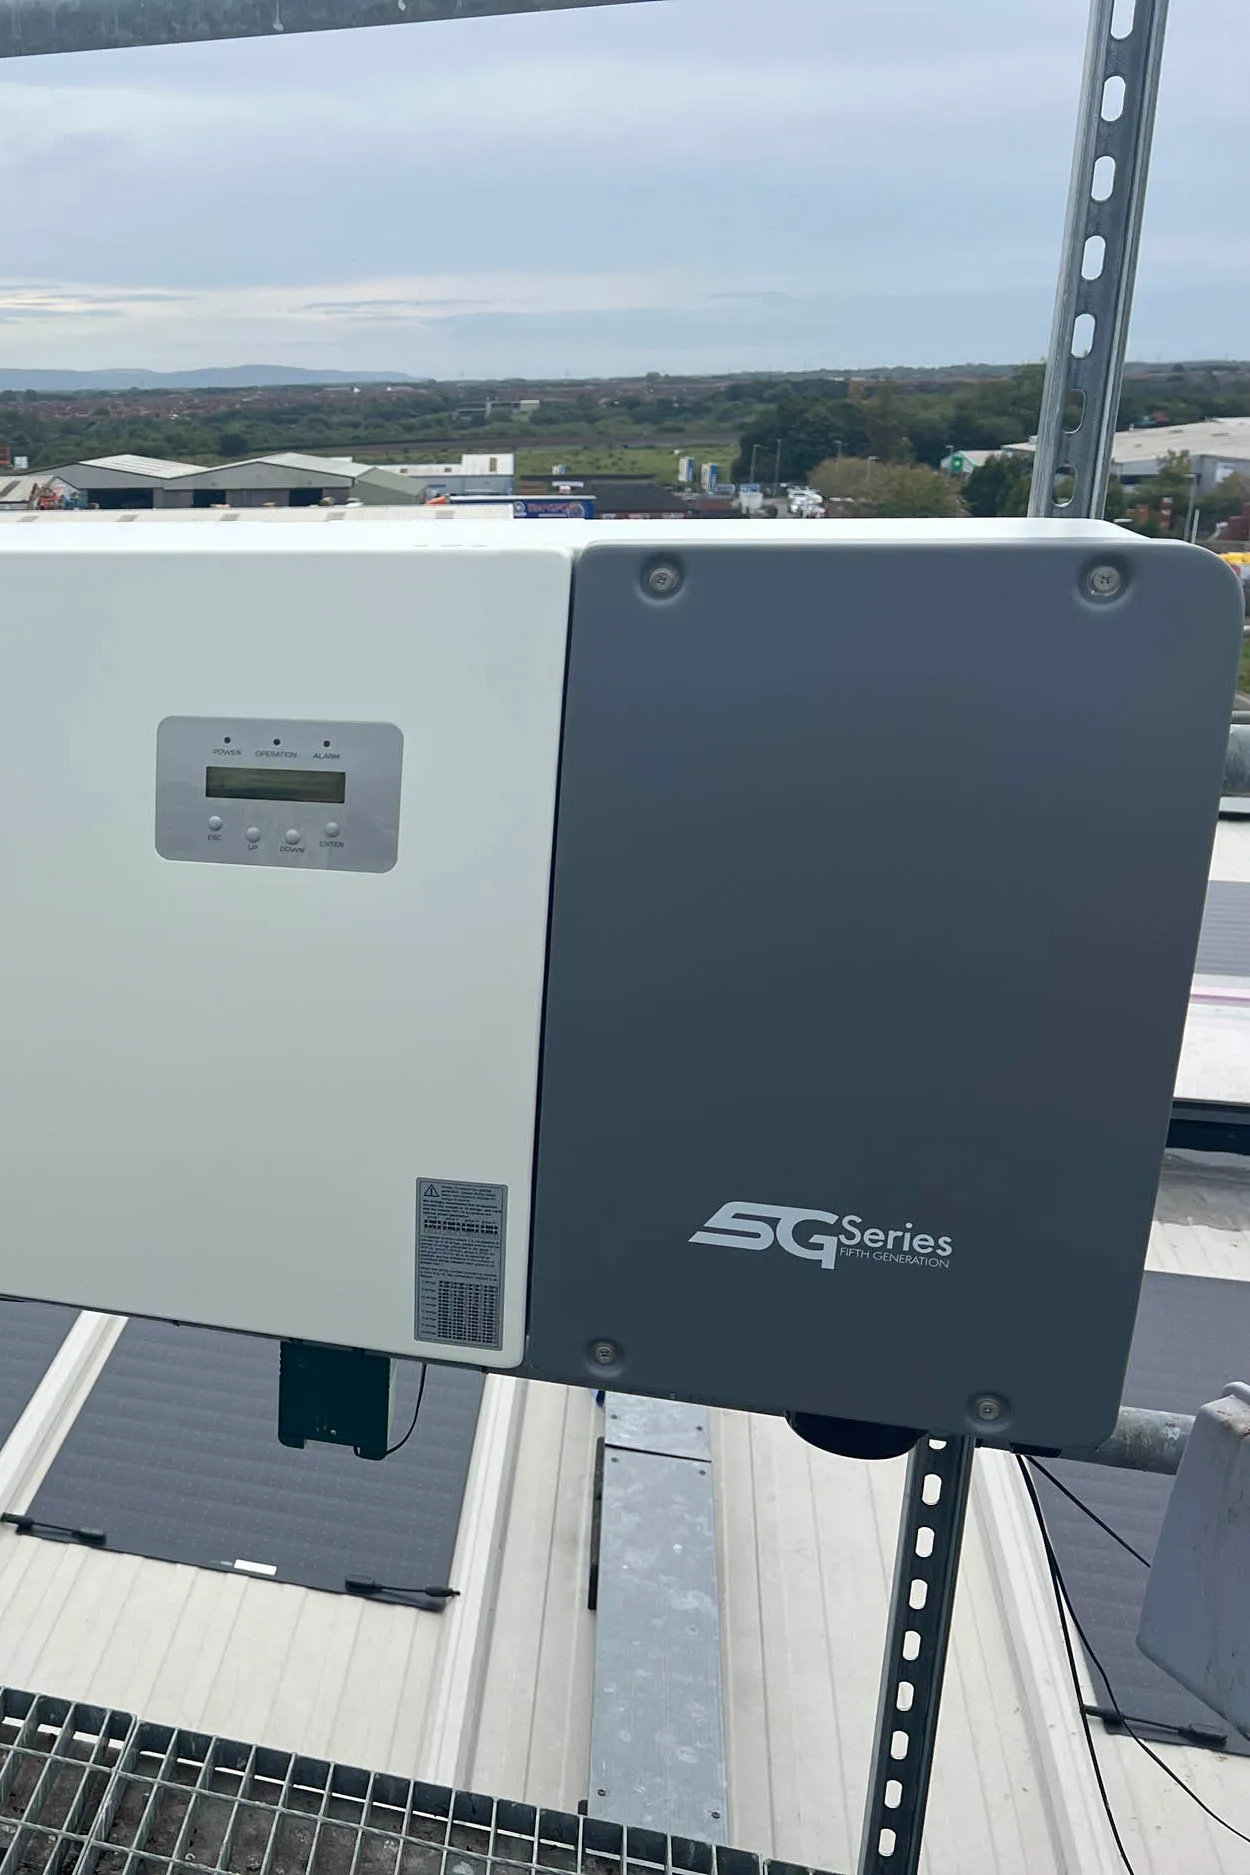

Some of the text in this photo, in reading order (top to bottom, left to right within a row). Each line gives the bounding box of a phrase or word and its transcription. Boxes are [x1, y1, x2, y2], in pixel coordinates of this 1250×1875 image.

[255, 750, 298, 759] OPERATION
[312, 752, 341, 760] ALARM
[279, 846, 305, 854] DOWN
[838, 1214, 953, 1257] Series
[839, 1247, 950, 1269] FIFTH GENERATION
